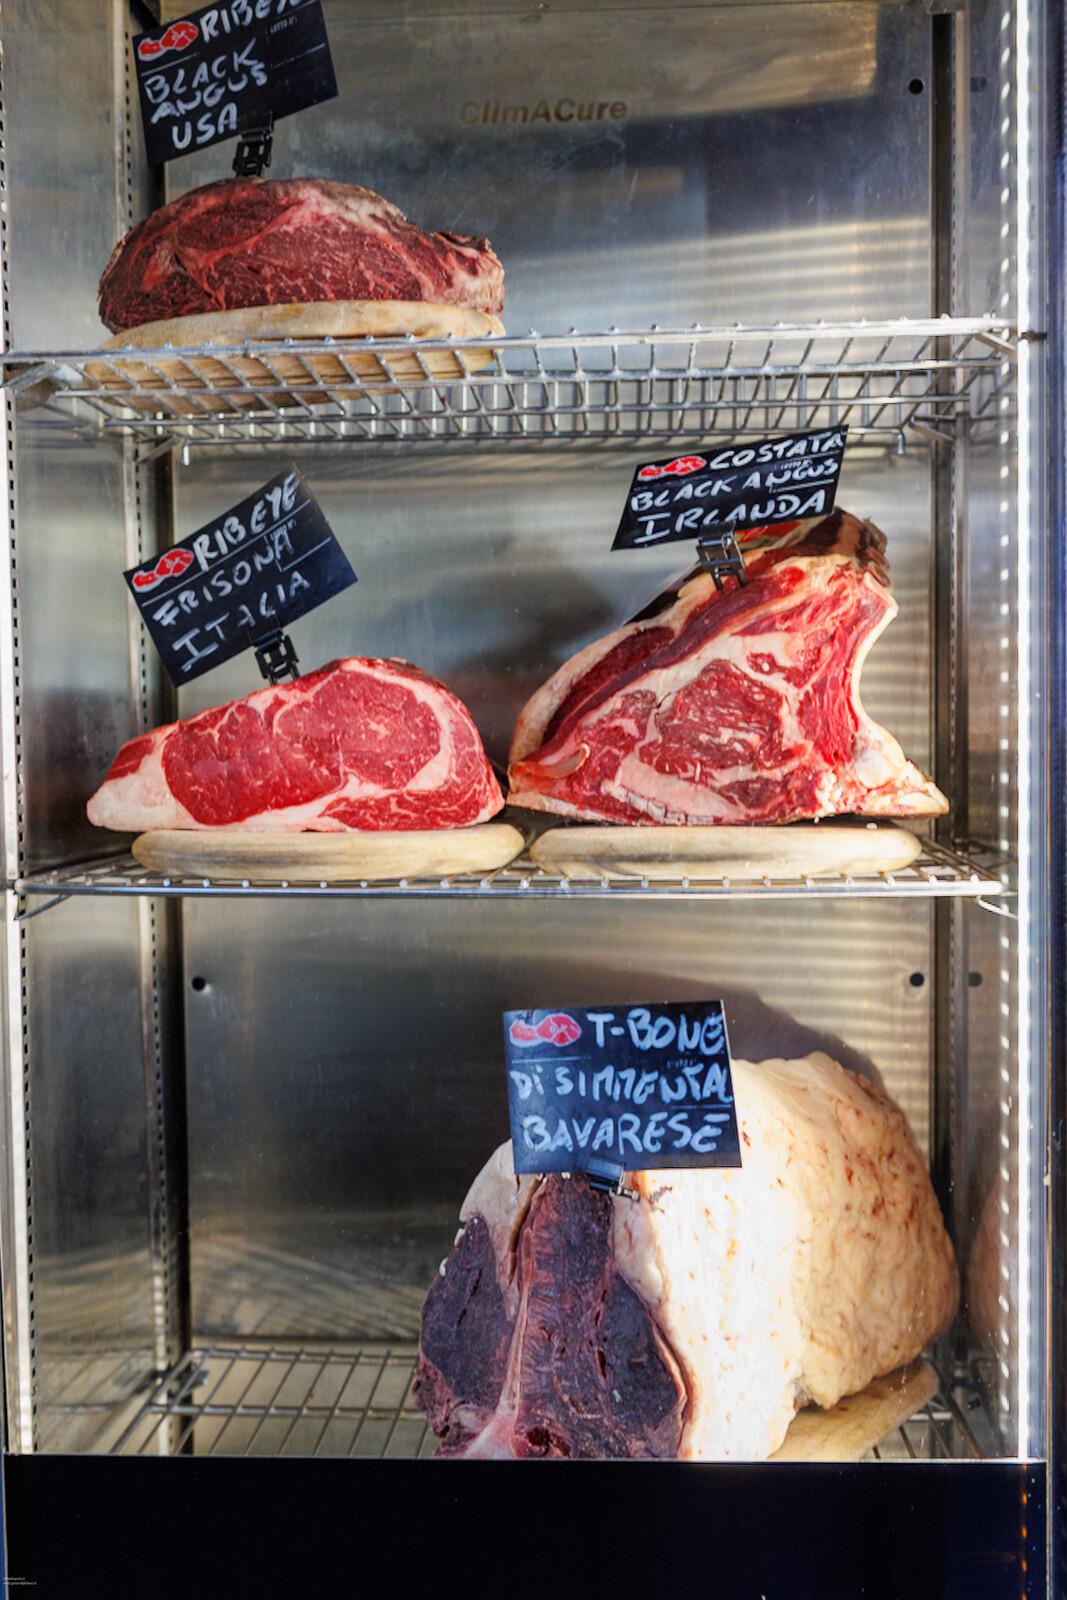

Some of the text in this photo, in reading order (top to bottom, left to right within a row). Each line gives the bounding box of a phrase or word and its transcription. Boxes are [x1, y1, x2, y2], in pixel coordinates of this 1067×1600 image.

[200, 0, 300, 43] RIBE
[144, 37, 258, 104] BLACK
[151, 62, 268, 124] ANGUS
[172, 102, 237, 149] USA
[459, 98, 628, 125] ClimACure
[709, 431, 844, 470] COSTATA
[631, 458, 839, 512] BLACK ANGUS
[193, 472, 300, 572] RIBEYE
[634, 489, 826, 544] IRLANDA
[152, 525, 295, 627] FRISONA
[172, 571, 311, 672] ITALIA
[586, 1008, 725, 1056] T-BONE
[555, 1062, 733, 1105] SIMMENTAL
[523, 1112, 730, 1155] BAVARESE
